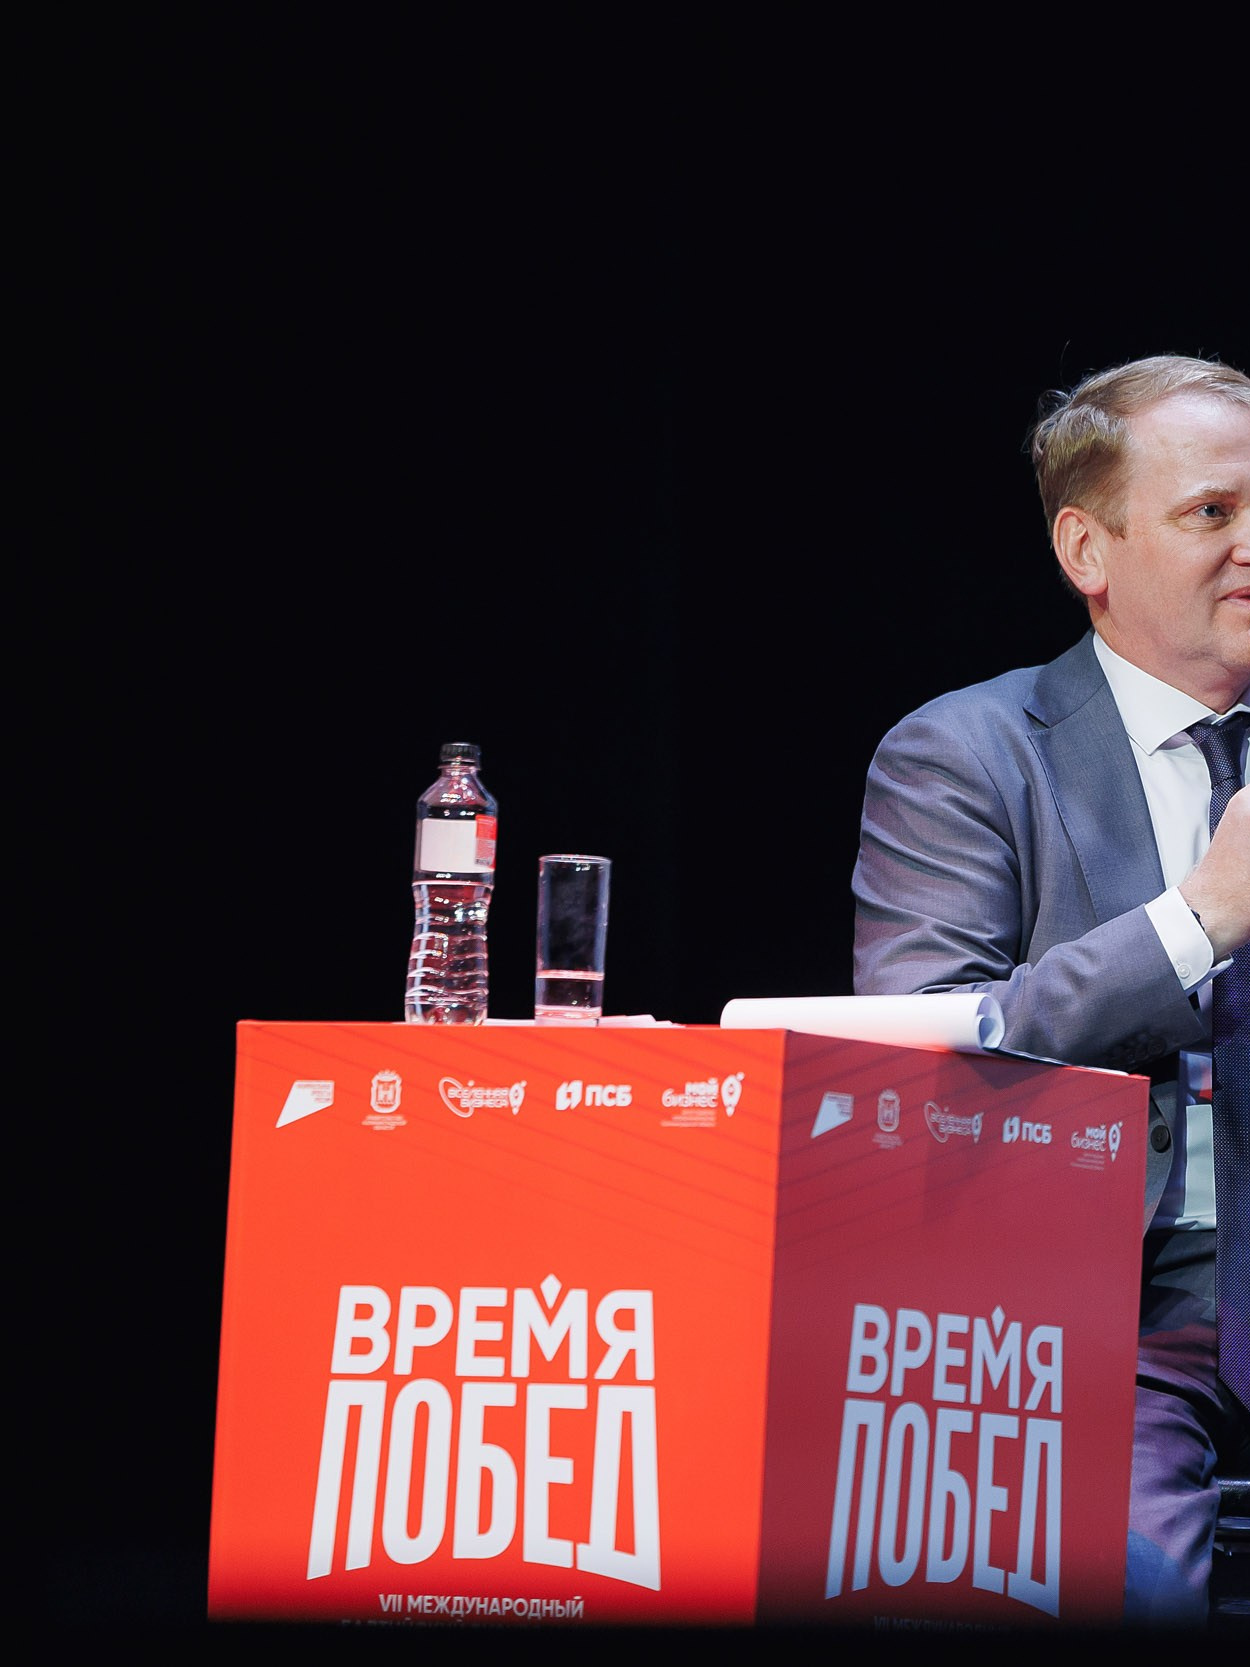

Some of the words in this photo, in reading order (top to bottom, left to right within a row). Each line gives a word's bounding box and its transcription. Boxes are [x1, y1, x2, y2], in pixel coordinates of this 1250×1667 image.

[585, 1084, 633, 1107] ПСБ
[1021, 1121, 1053, 1145] ПСБ
[330, 1274, 656, 1381] ВРЕМЯ
[845, 1303, 1064, 1414] ВРЕМЯ
[306, 1378, 662, 1592] ПОБЕД
[824, 1397, 1063, 1619] ПОБЕД
[379, 1594, 403, 1612] VII
[407, 1595, 585, 1619] МЕЖДУНАРОДНЫЙ
